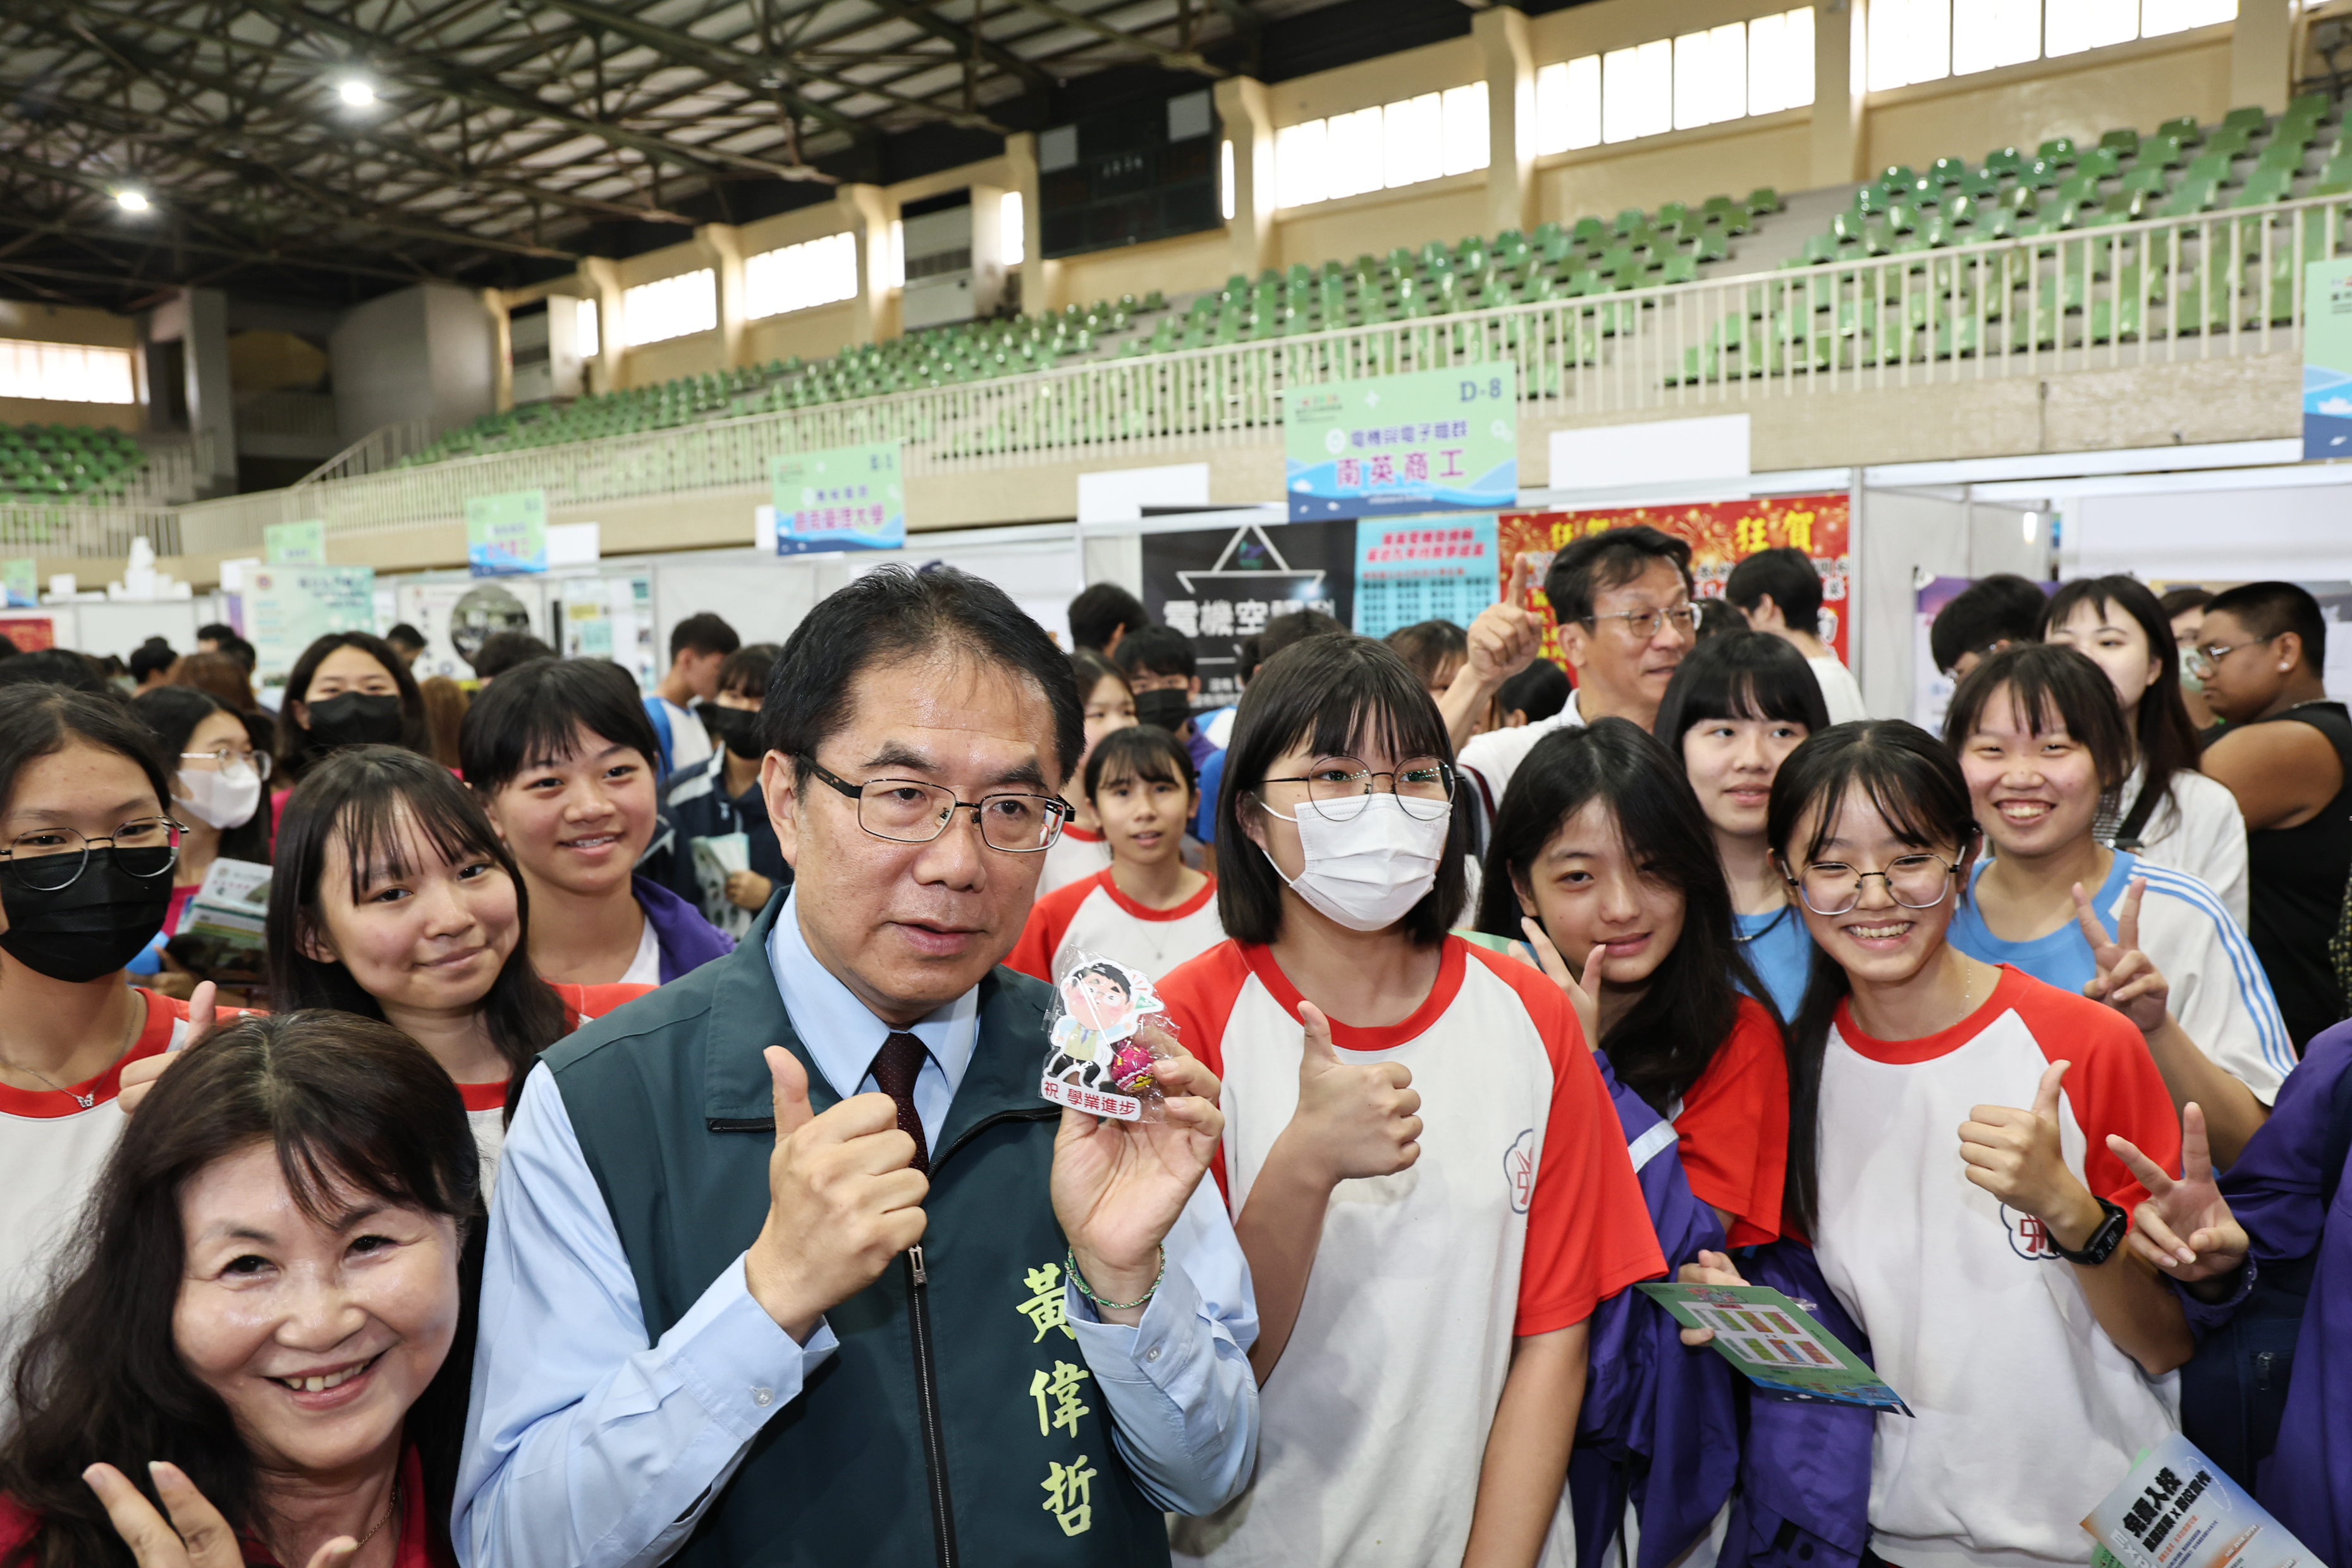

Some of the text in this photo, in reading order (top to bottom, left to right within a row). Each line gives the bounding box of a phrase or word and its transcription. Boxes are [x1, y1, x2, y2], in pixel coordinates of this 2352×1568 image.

[1460, 377, 1502, 402] D-8
[1337, 450, 1464, 486] 南英商工
[1736, 509, 1816, 554] 狂賀
[1044, 1081, 1136, 1115] 祝 學業進步
[1015, 1262, 1098, 1537] 黃偉哲
